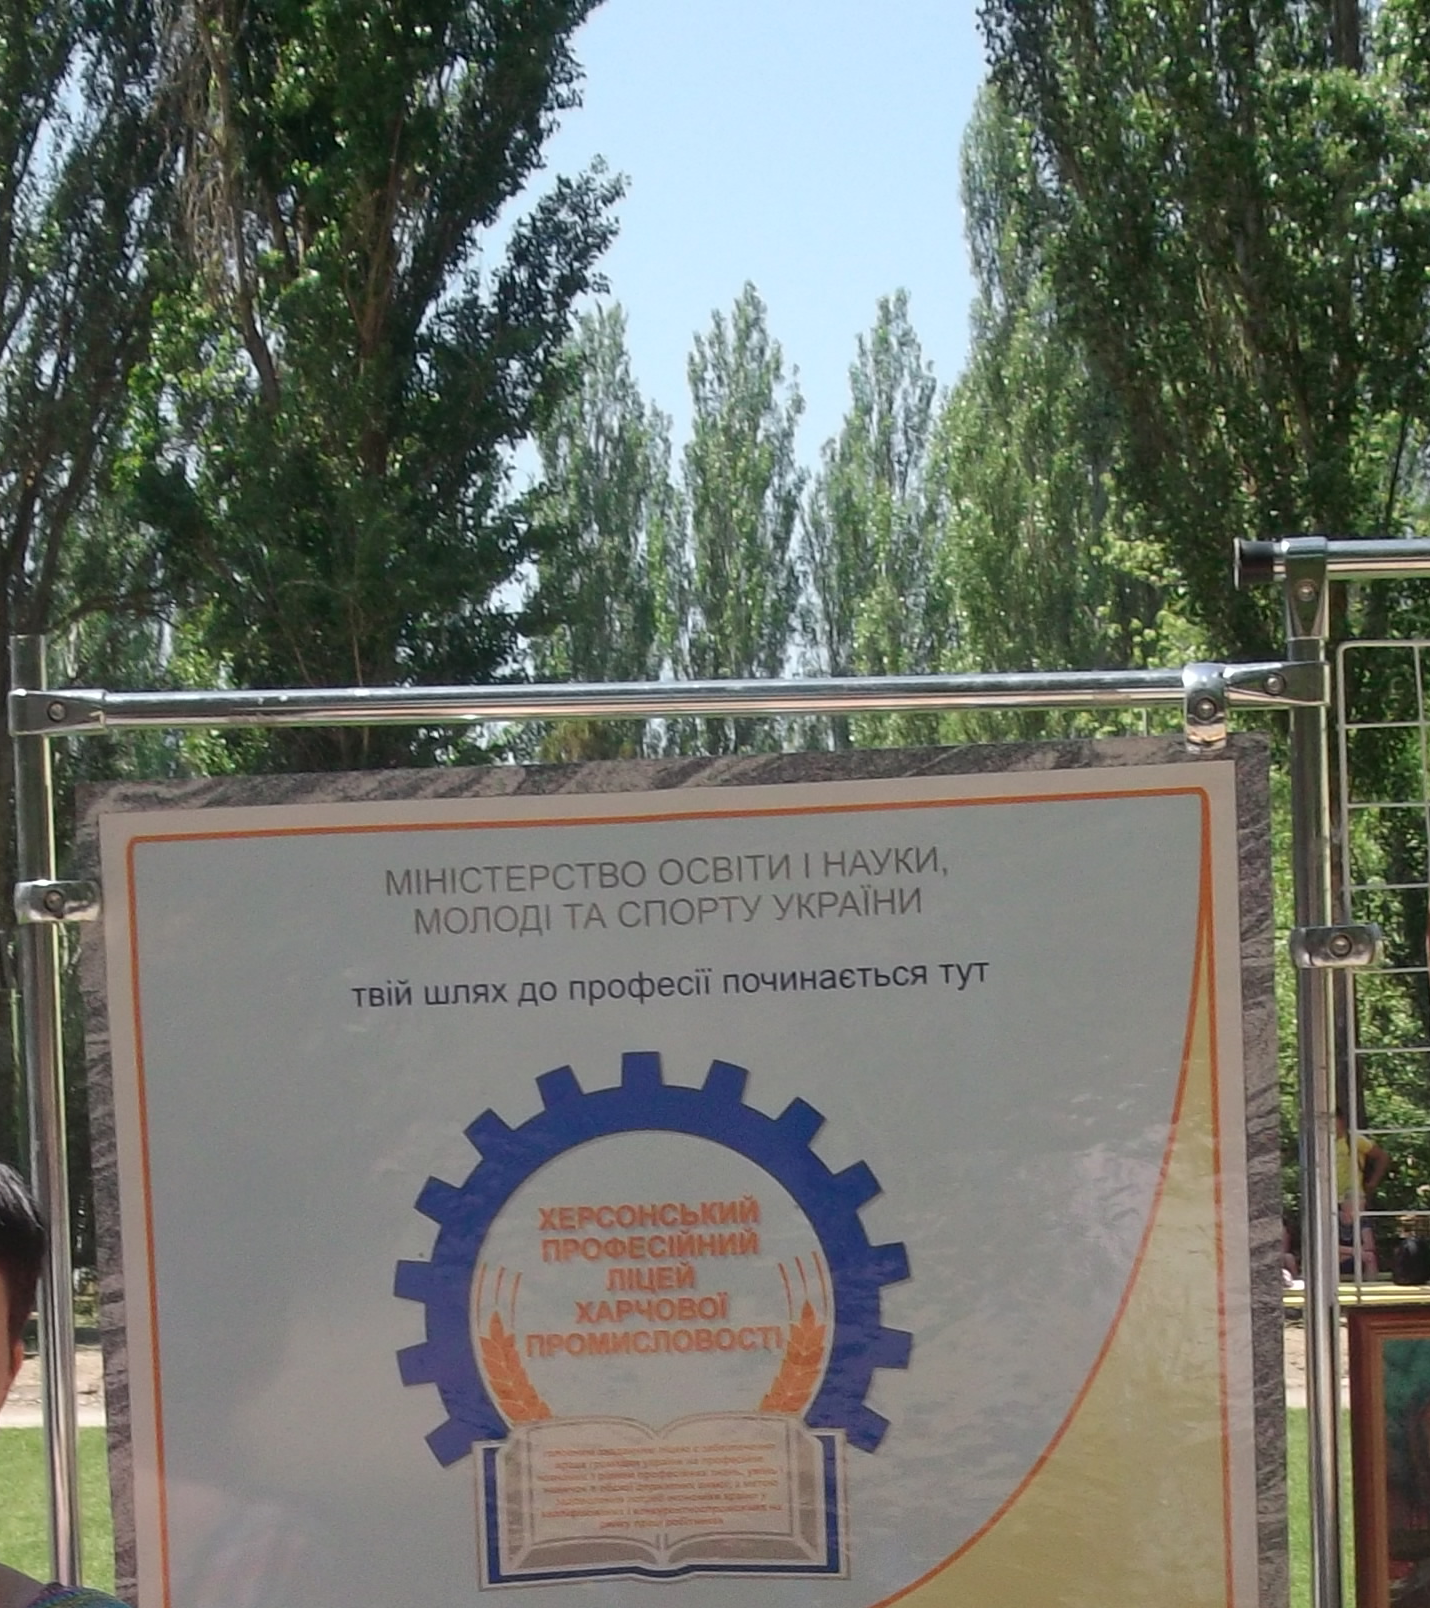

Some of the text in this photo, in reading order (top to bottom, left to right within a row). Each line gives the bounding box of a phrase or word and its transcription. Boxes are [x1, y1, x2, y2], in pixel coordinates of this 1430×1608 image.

[386, 846, 949, 896] МІНІСТЕРСТВО ОСВІТИ І НАУКИ,
[415, 884, 921, 937] МОЛОДІ ТА СПОРТУ УКРАЇНИ
[351, 962, 989, 1007] твій шлях до професії починається тут
[539, 1195, 759, 1231] ХЕРСОНСЬКИЙ
[542, 1229, 759, 1263] ПРОФЕСІЙНИЙ
[607, 1262, 696, 1292] ЛІЦЕЙ
[575, 1292, 729, 1325] ХАРЧОВОЇ
[526, 1326, 784, 1358] ПРОМИСЛОВОСТІ
